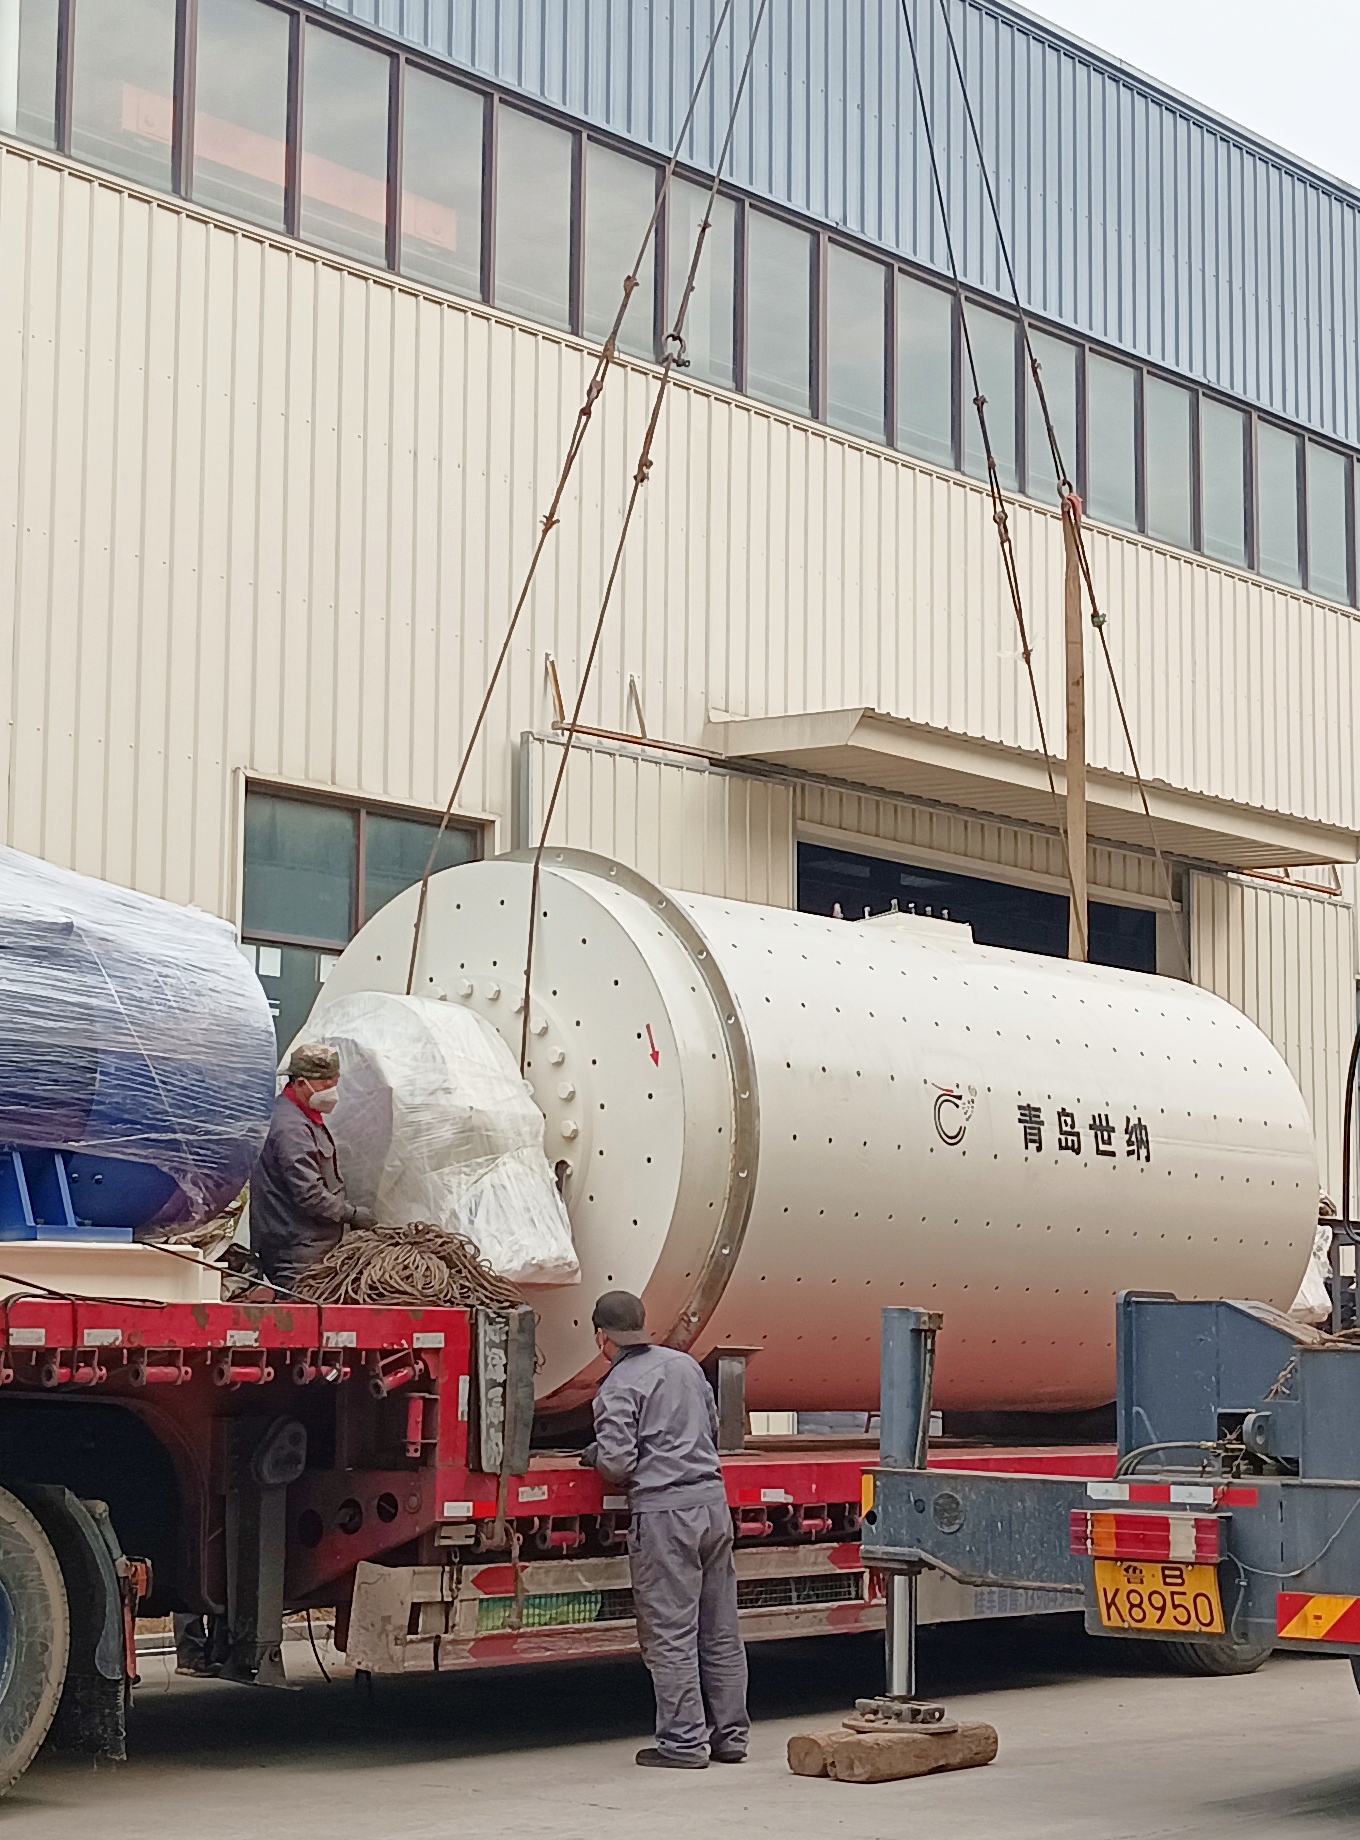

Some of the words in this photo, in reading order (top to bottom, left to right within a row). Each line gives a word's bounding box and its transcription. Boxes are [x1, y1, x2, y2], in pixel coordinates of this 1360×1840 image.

[1017, 1103, 1151, 1162] 青岛世纳
[1103, 1587, 1215, 1627] K8950
